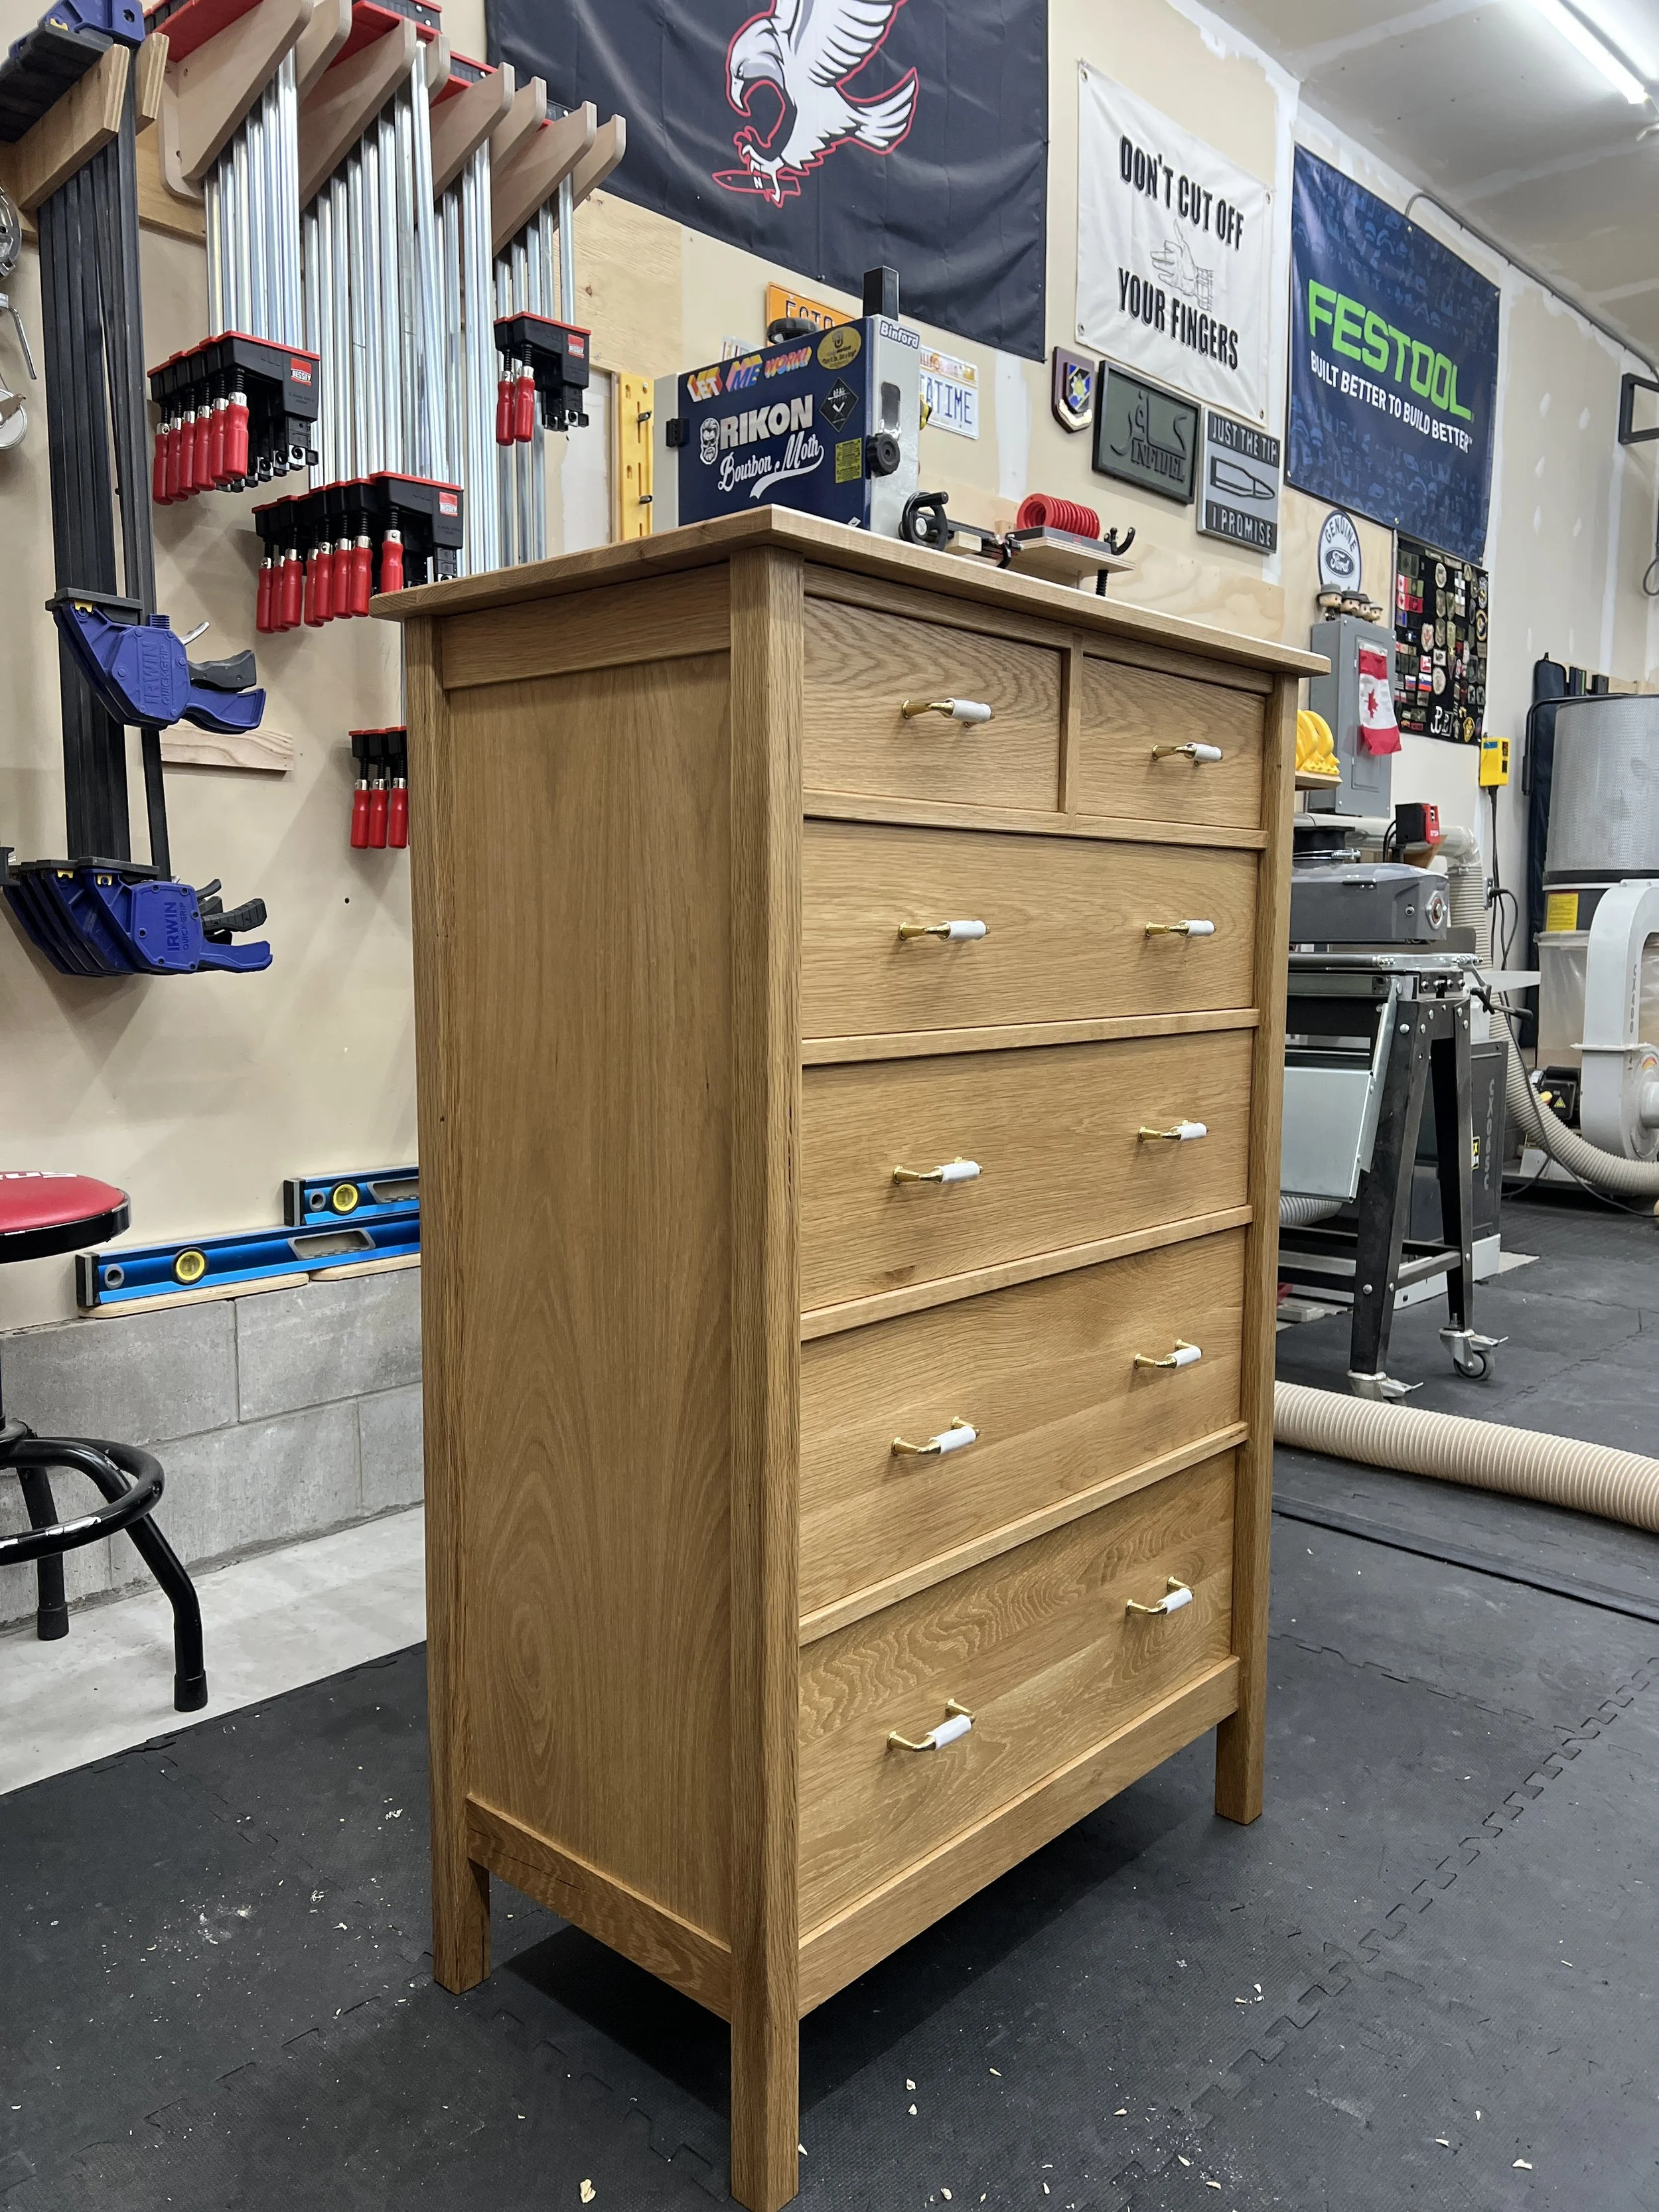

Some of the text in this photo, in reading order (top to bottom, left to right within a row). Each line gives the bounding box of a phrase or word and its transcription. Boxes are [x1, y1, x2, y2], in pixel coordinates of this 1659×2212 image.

[1119, 134, 1244, 252] DON'T CUT OFF
[880, 320, 920, 350] Binford
[1118, 267, 1239, 370] YOUR FINGERS
[292, 370, 312, 382] BESSEY
[687, 366, 723, 403] LET
[725, 354, 763, 393] ME
[764, 345, 812, 379] WORK!
[1309, 279, 1472, 421] FESTOOL
[1311, 349, 1339, 388] BUILT
[1340, 370, 1386, 411] BETTER
[1388, 394, 1402, 419] TO
[1403, 402, 1431, 435] BUILD
[720, 394, 813, 451] RIKON
[1212, 415, 1277, 463] JUST THE TIP
[718, 452, 772, 492] Bourbon
[775, 431, 819, 473] Moth
[1130, 437, 1185, 482] INFIDEL
[1212, 505, 1272, 546] I PROMISE
[1325, 516, 1358, 552] GENUINE
[1330, 550, 1350, 573] Ford
[143, 642, 160, 704] IRWIN
[164, 902, 180, 951] IRWIN
